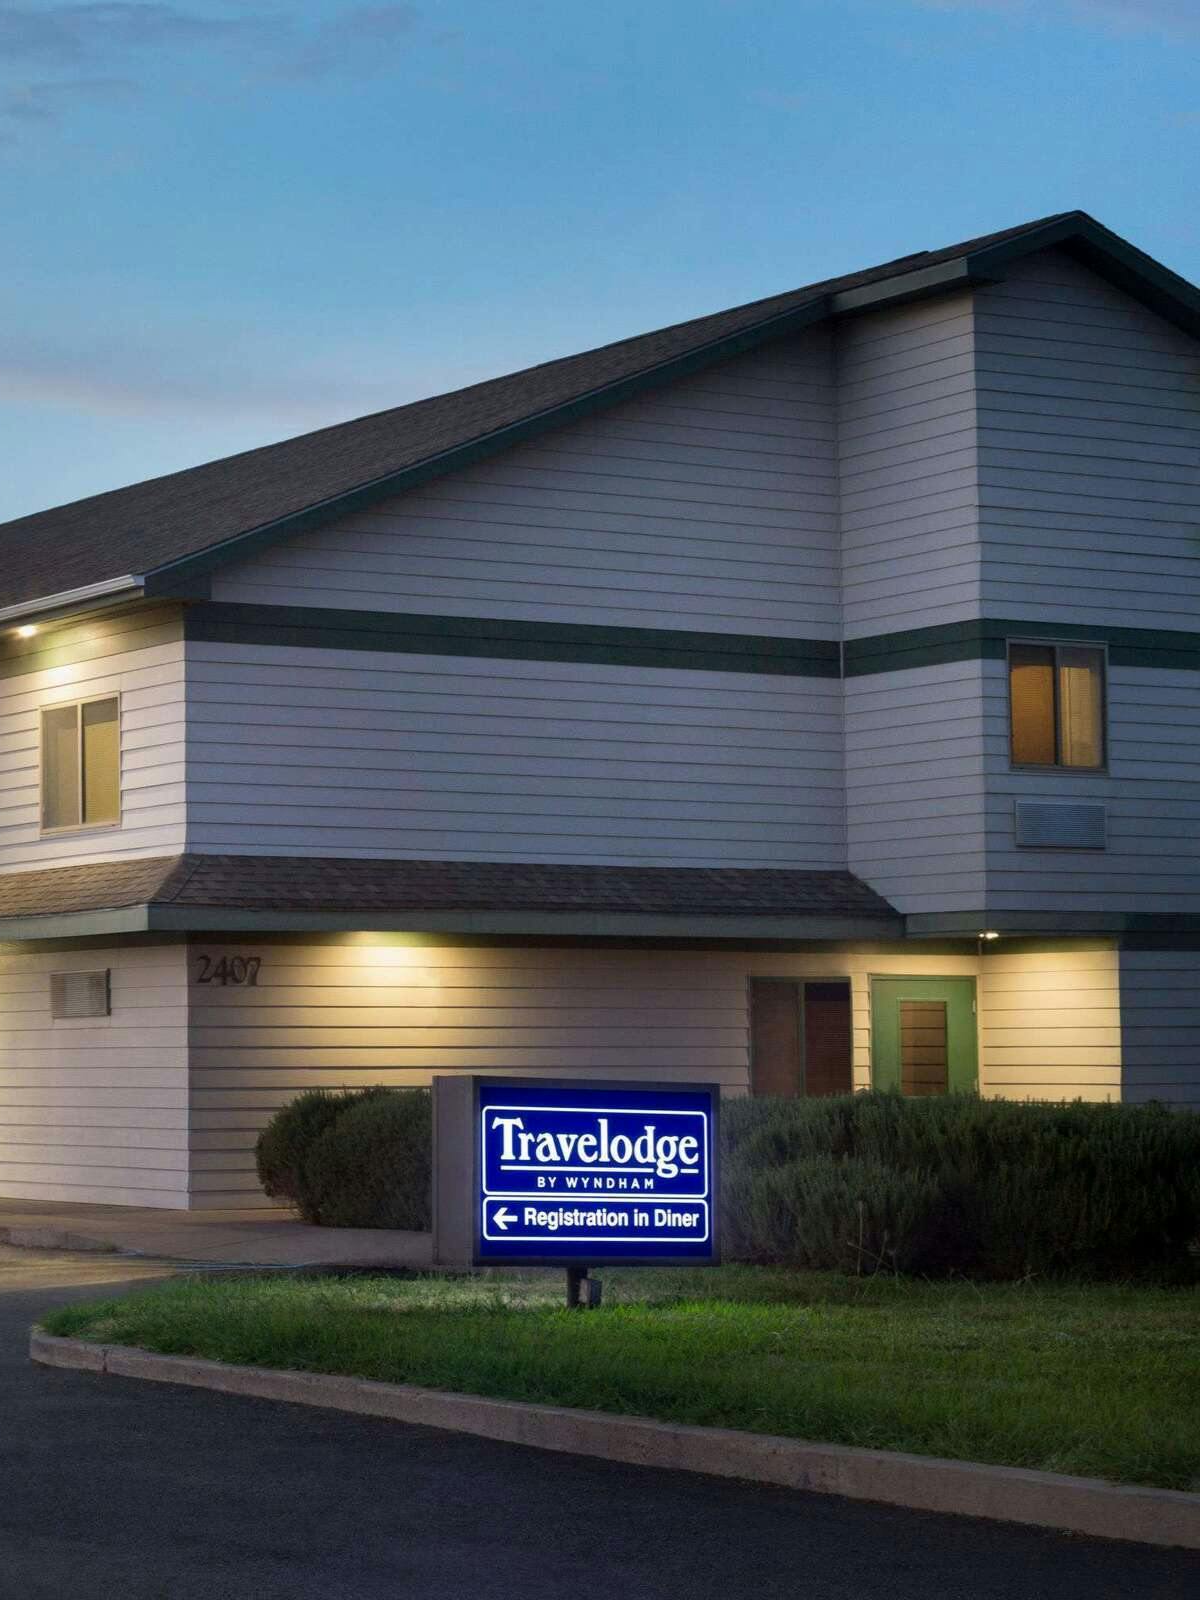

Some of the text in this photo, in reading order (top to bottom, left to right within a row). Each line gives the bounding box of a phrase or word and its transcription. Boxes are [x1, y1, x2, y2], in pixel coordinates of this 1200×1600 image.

[196, 954, 261, 986] 2407
[491, 1116, 699, 1178] Travelodge
[537, 1176, 654, 1189] BY WYNDHAM
[523, 1207, 700, 1231] Registration in Diner
